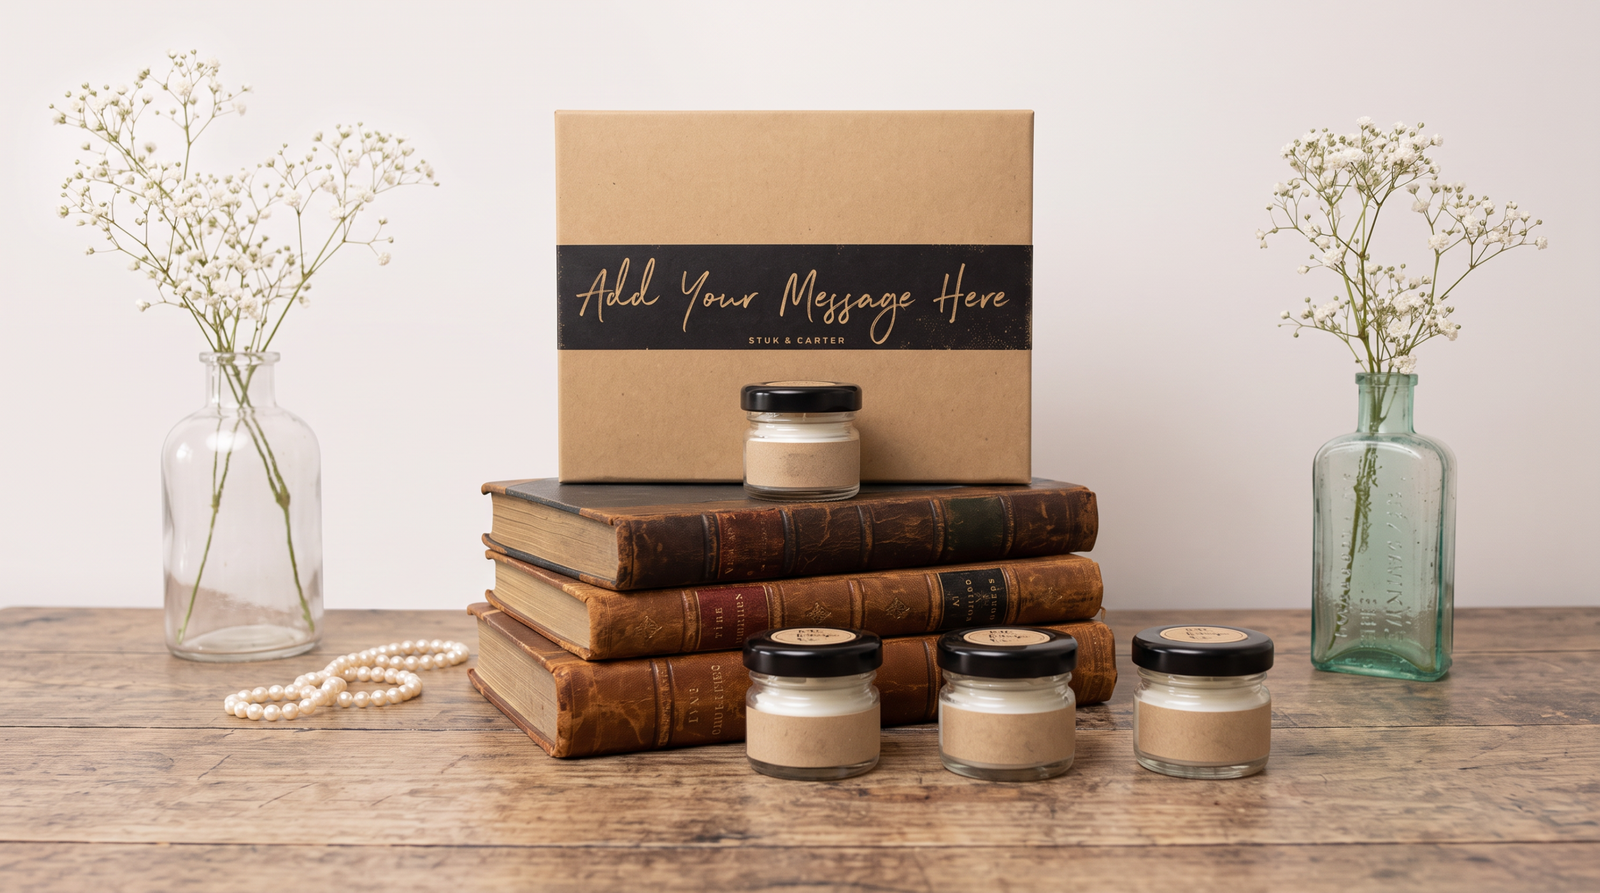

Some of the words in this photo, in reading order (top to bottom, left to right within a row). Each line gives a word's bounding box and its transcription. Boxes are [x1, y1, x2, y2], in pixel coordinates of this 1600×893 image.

[576, 257, 660, 323] Add
[681, 270, 759, 333] Your
[779, 268, 916, 345] Message
[933, 262, 1010, 324] Here
[748, 336, 779, 345] STUK
[784, 336, 792, 345] &
[796, 336, 846, 345] CARTER
